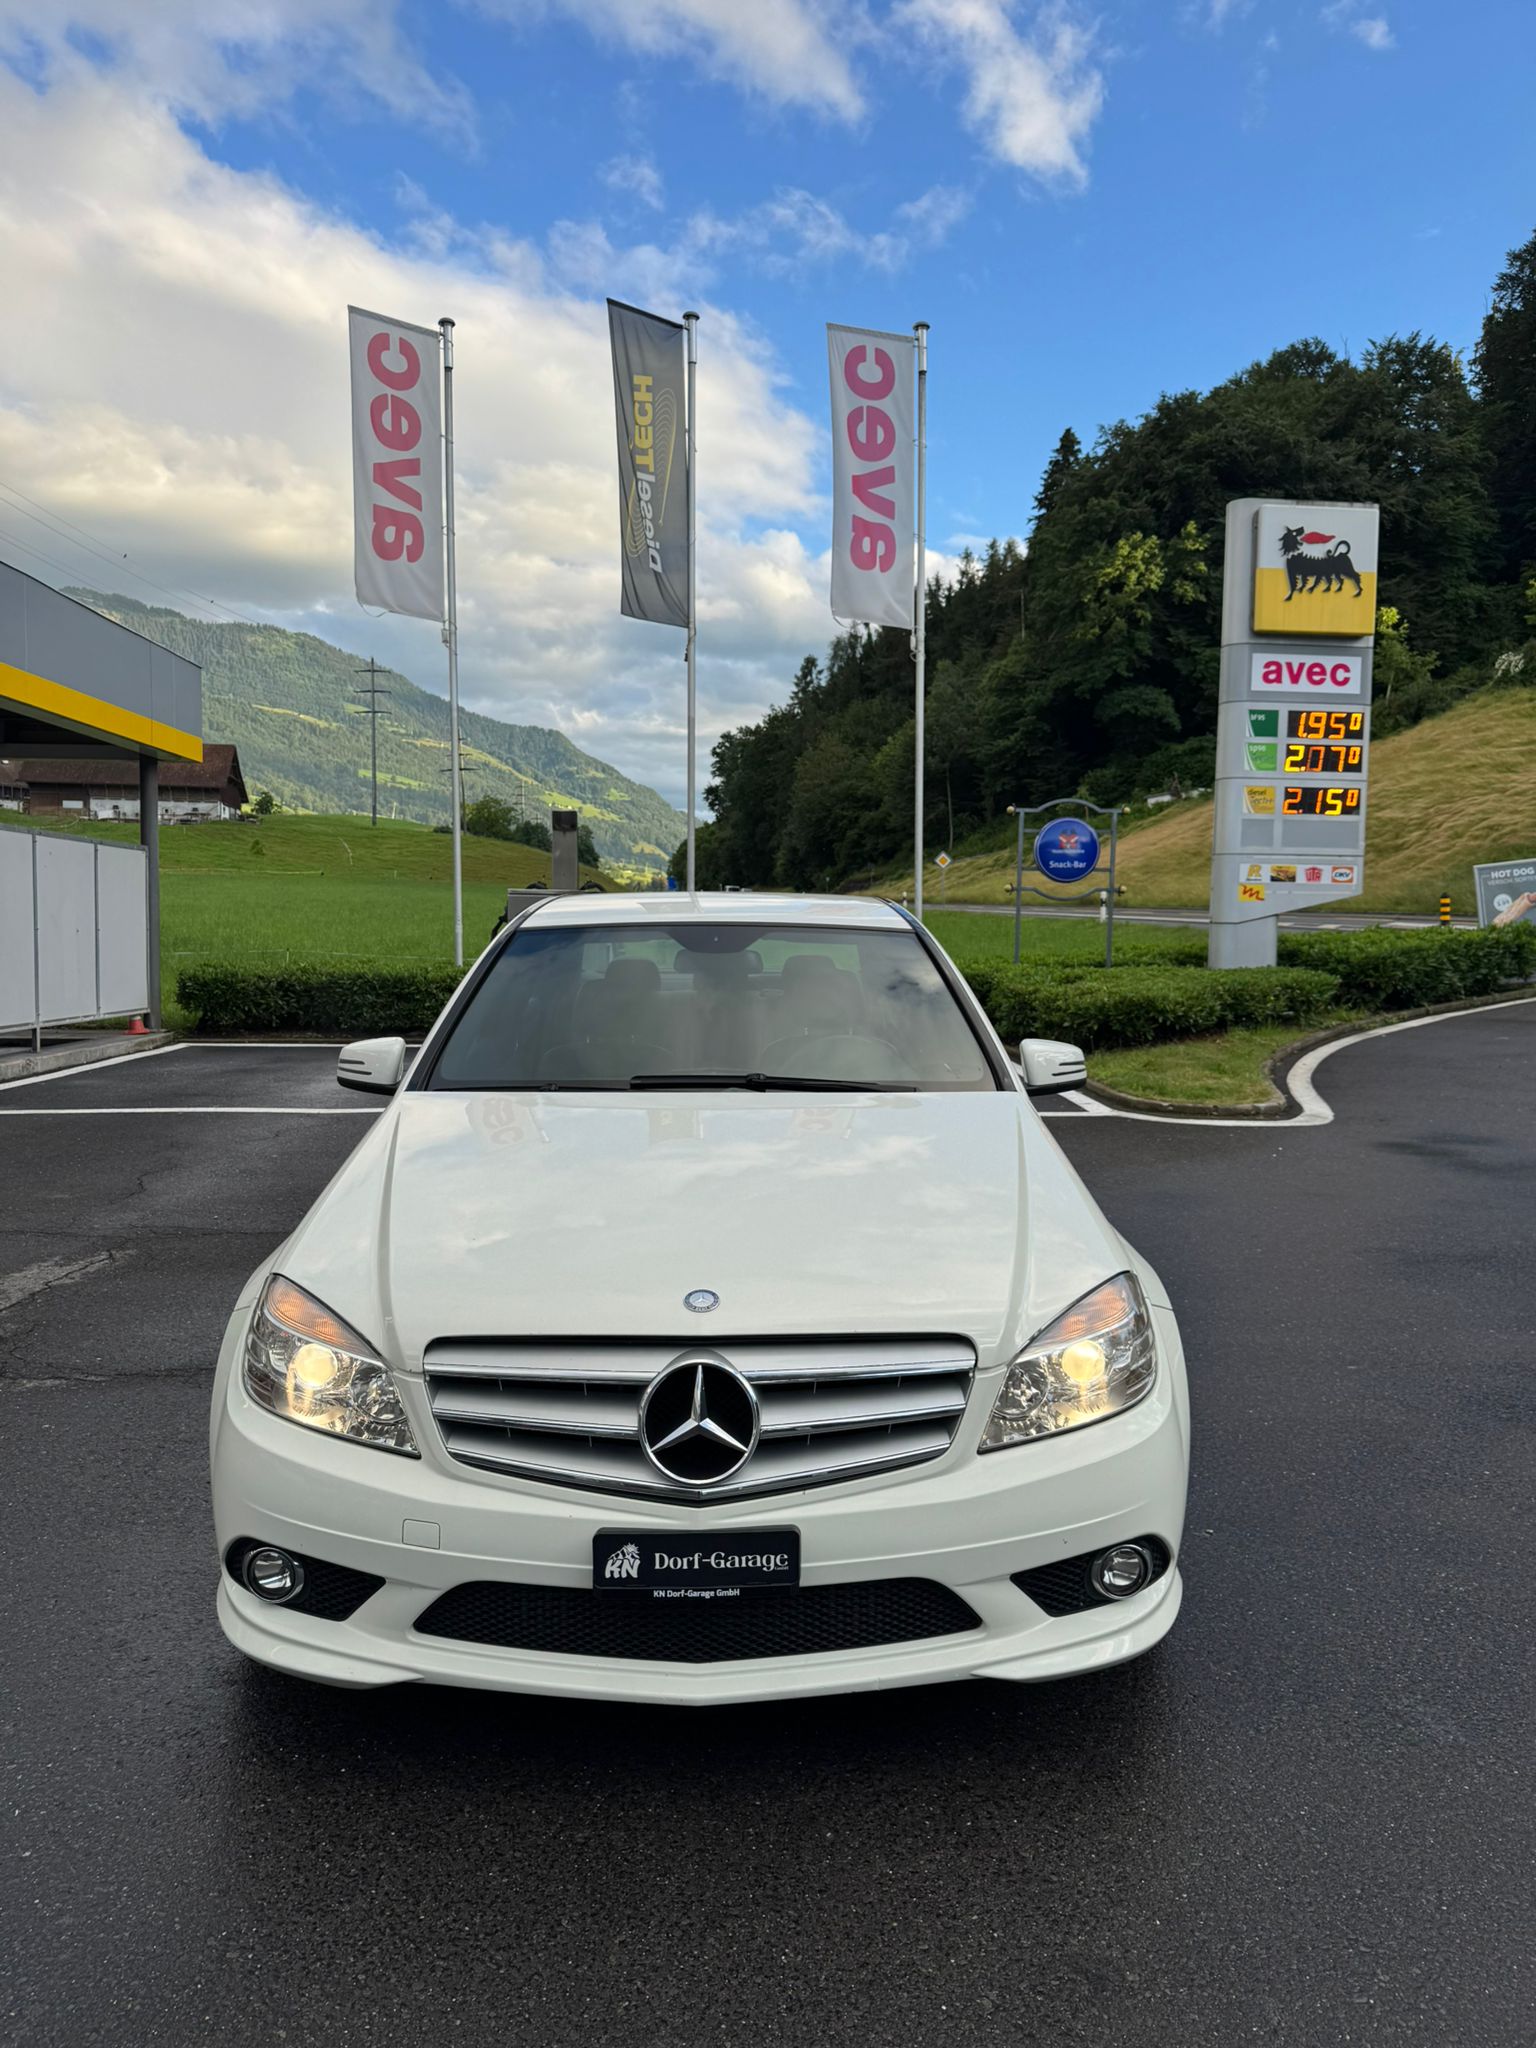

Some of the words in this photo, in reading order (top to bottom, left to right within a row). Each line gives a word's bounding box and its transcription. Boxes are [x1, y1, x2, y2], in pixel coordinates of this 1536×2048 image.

[1262, 660, 1351, 687] avec
[1049, 860, 1087, 869] Snack-Bar
[1491, 870, 1512, 879] HOT
[1513, 867, 1535, 876] DOG
[604, 1558, 641, 1578] KN
[654, 1551, 789, 1572] Dorf-Garage
[667, 1589, 715, 1598] Dorf-Garage
[716, 1588, 740, 1597] GmbH
